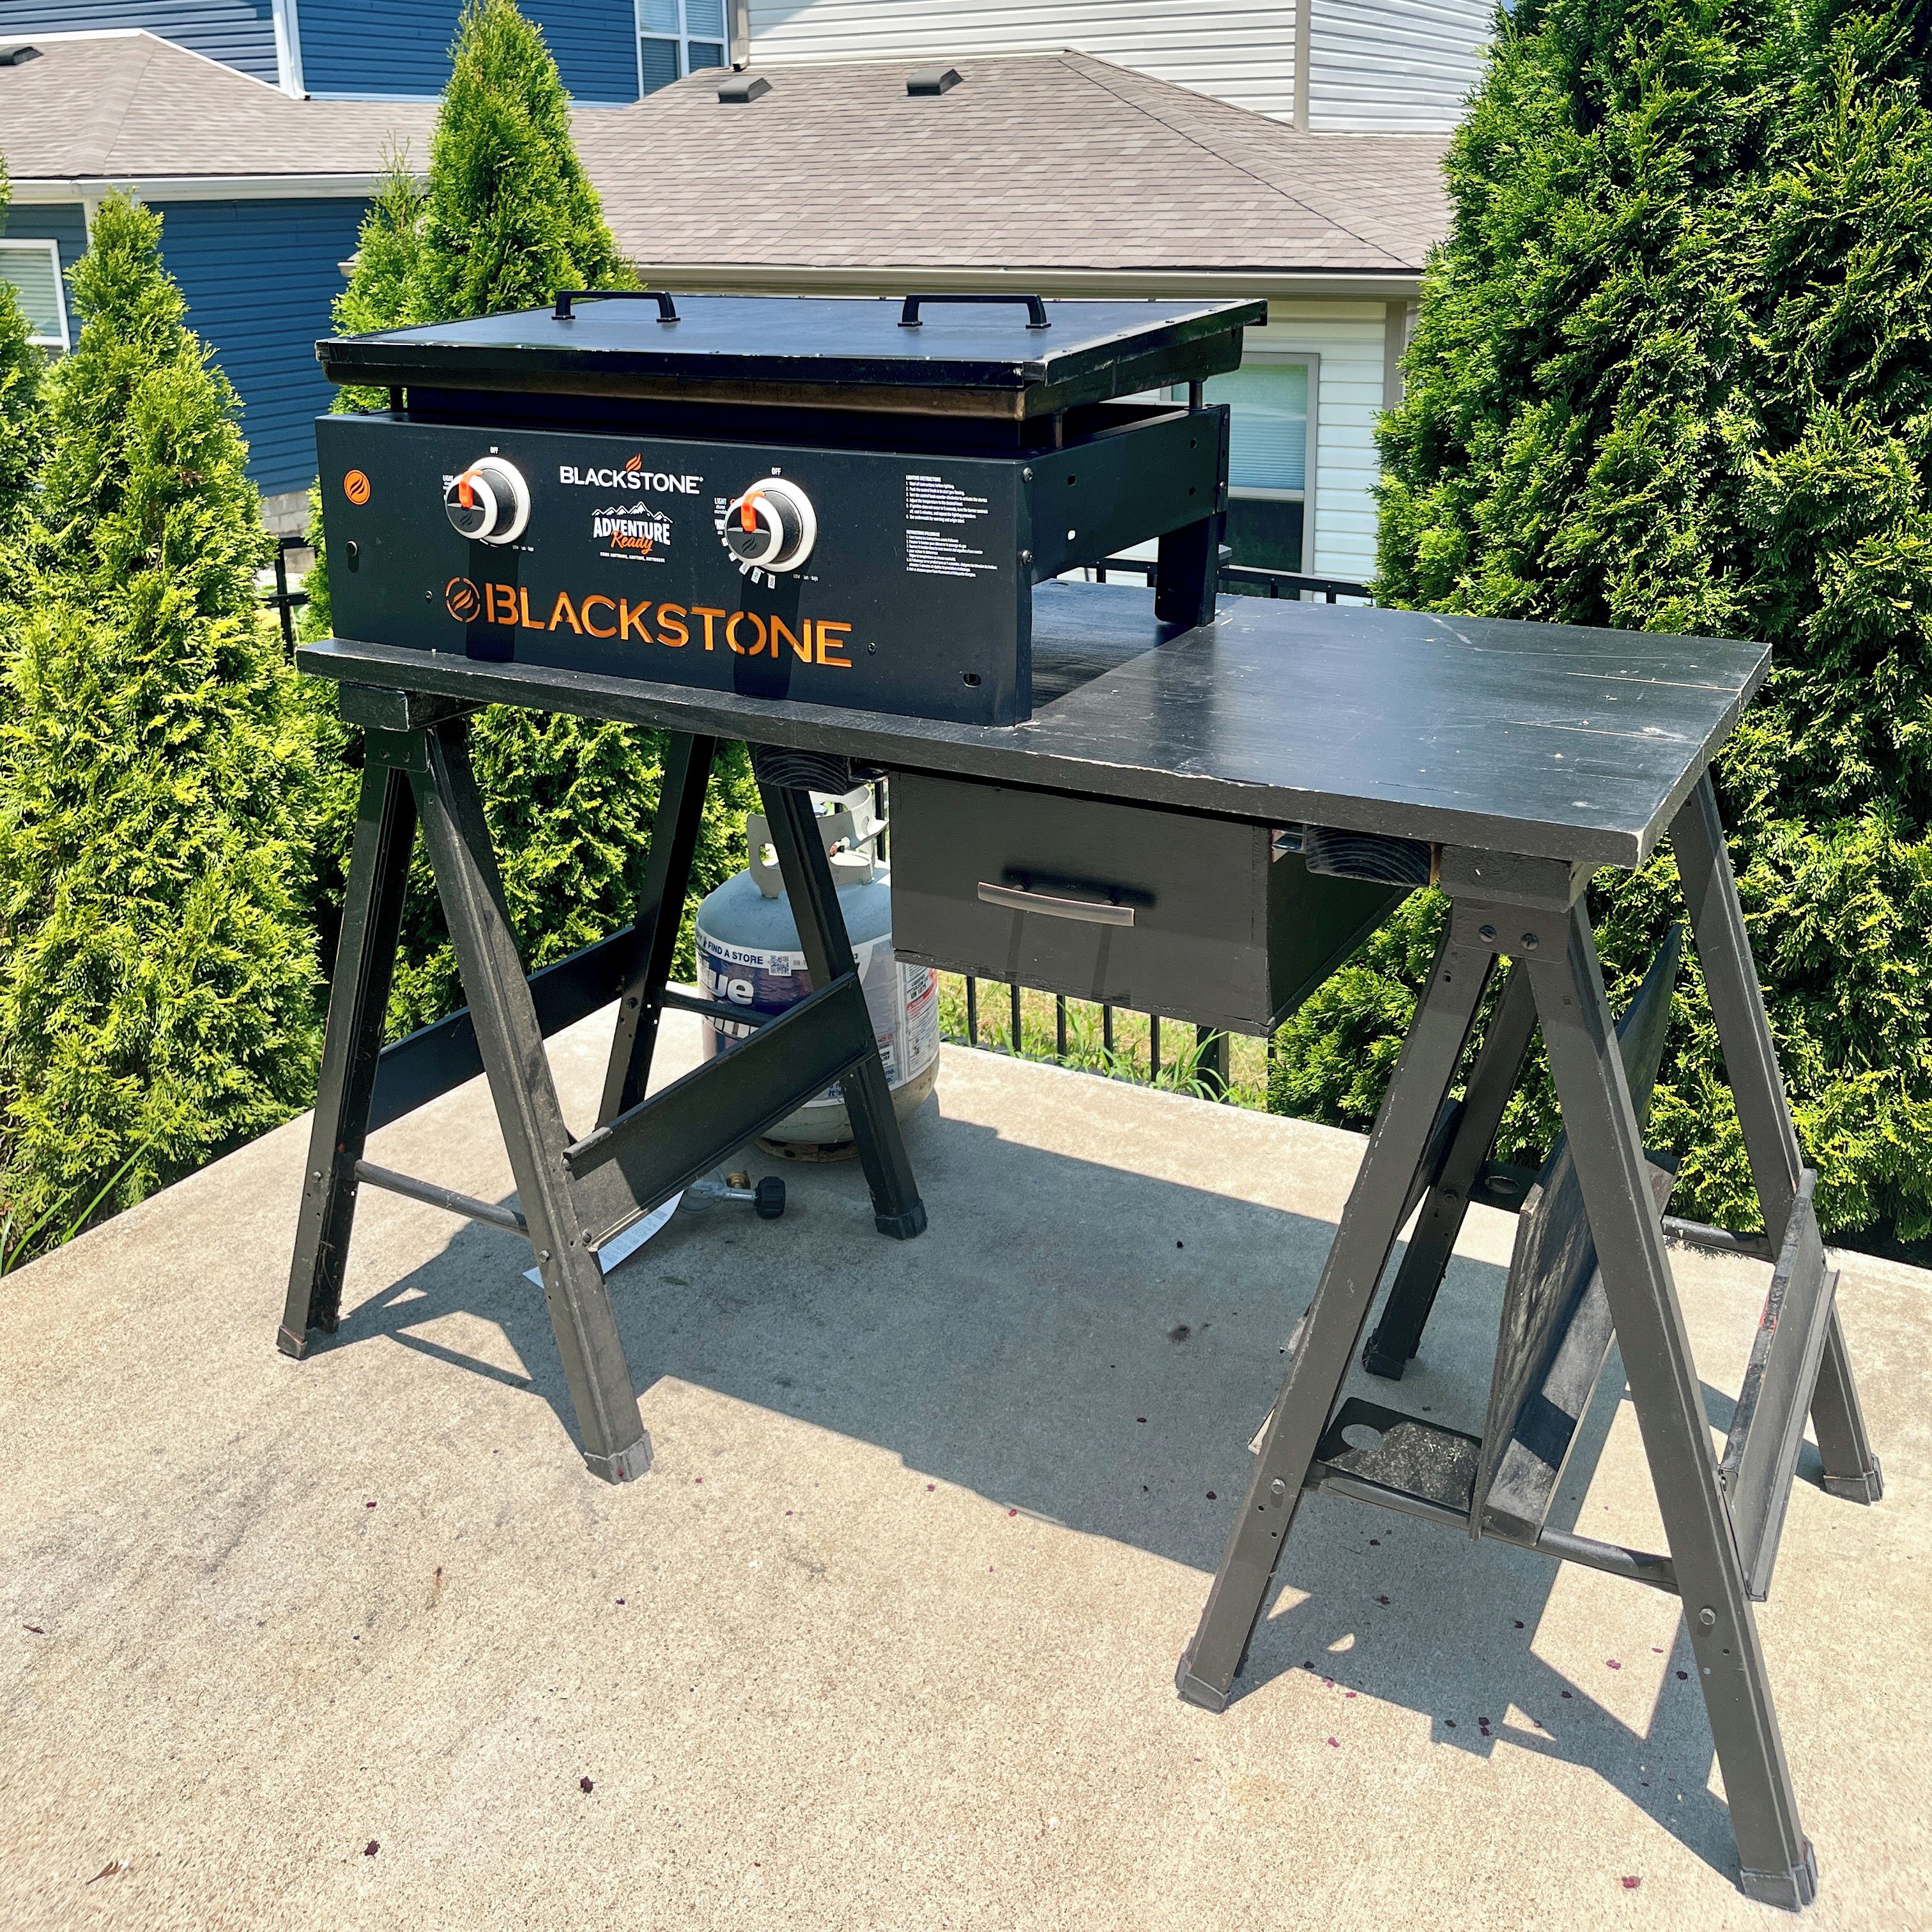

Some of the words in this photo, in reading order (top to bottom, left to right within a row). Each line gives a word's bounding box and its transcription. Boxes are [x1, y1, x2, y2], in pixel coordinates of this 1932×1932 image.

[560, 465, 700, 494] BLACKSTONE
[771, 467, 781, 475] OFF
[593, 517, 671, 545] ADVENTURE
[610, 531, 653, 555] Ready
[487, 582, 852, 668] BLACKSTONE
[708, 940, 723, 955] FIND
[724, 949, 730, 958] A
[732, 951, 763, 965] STORE
